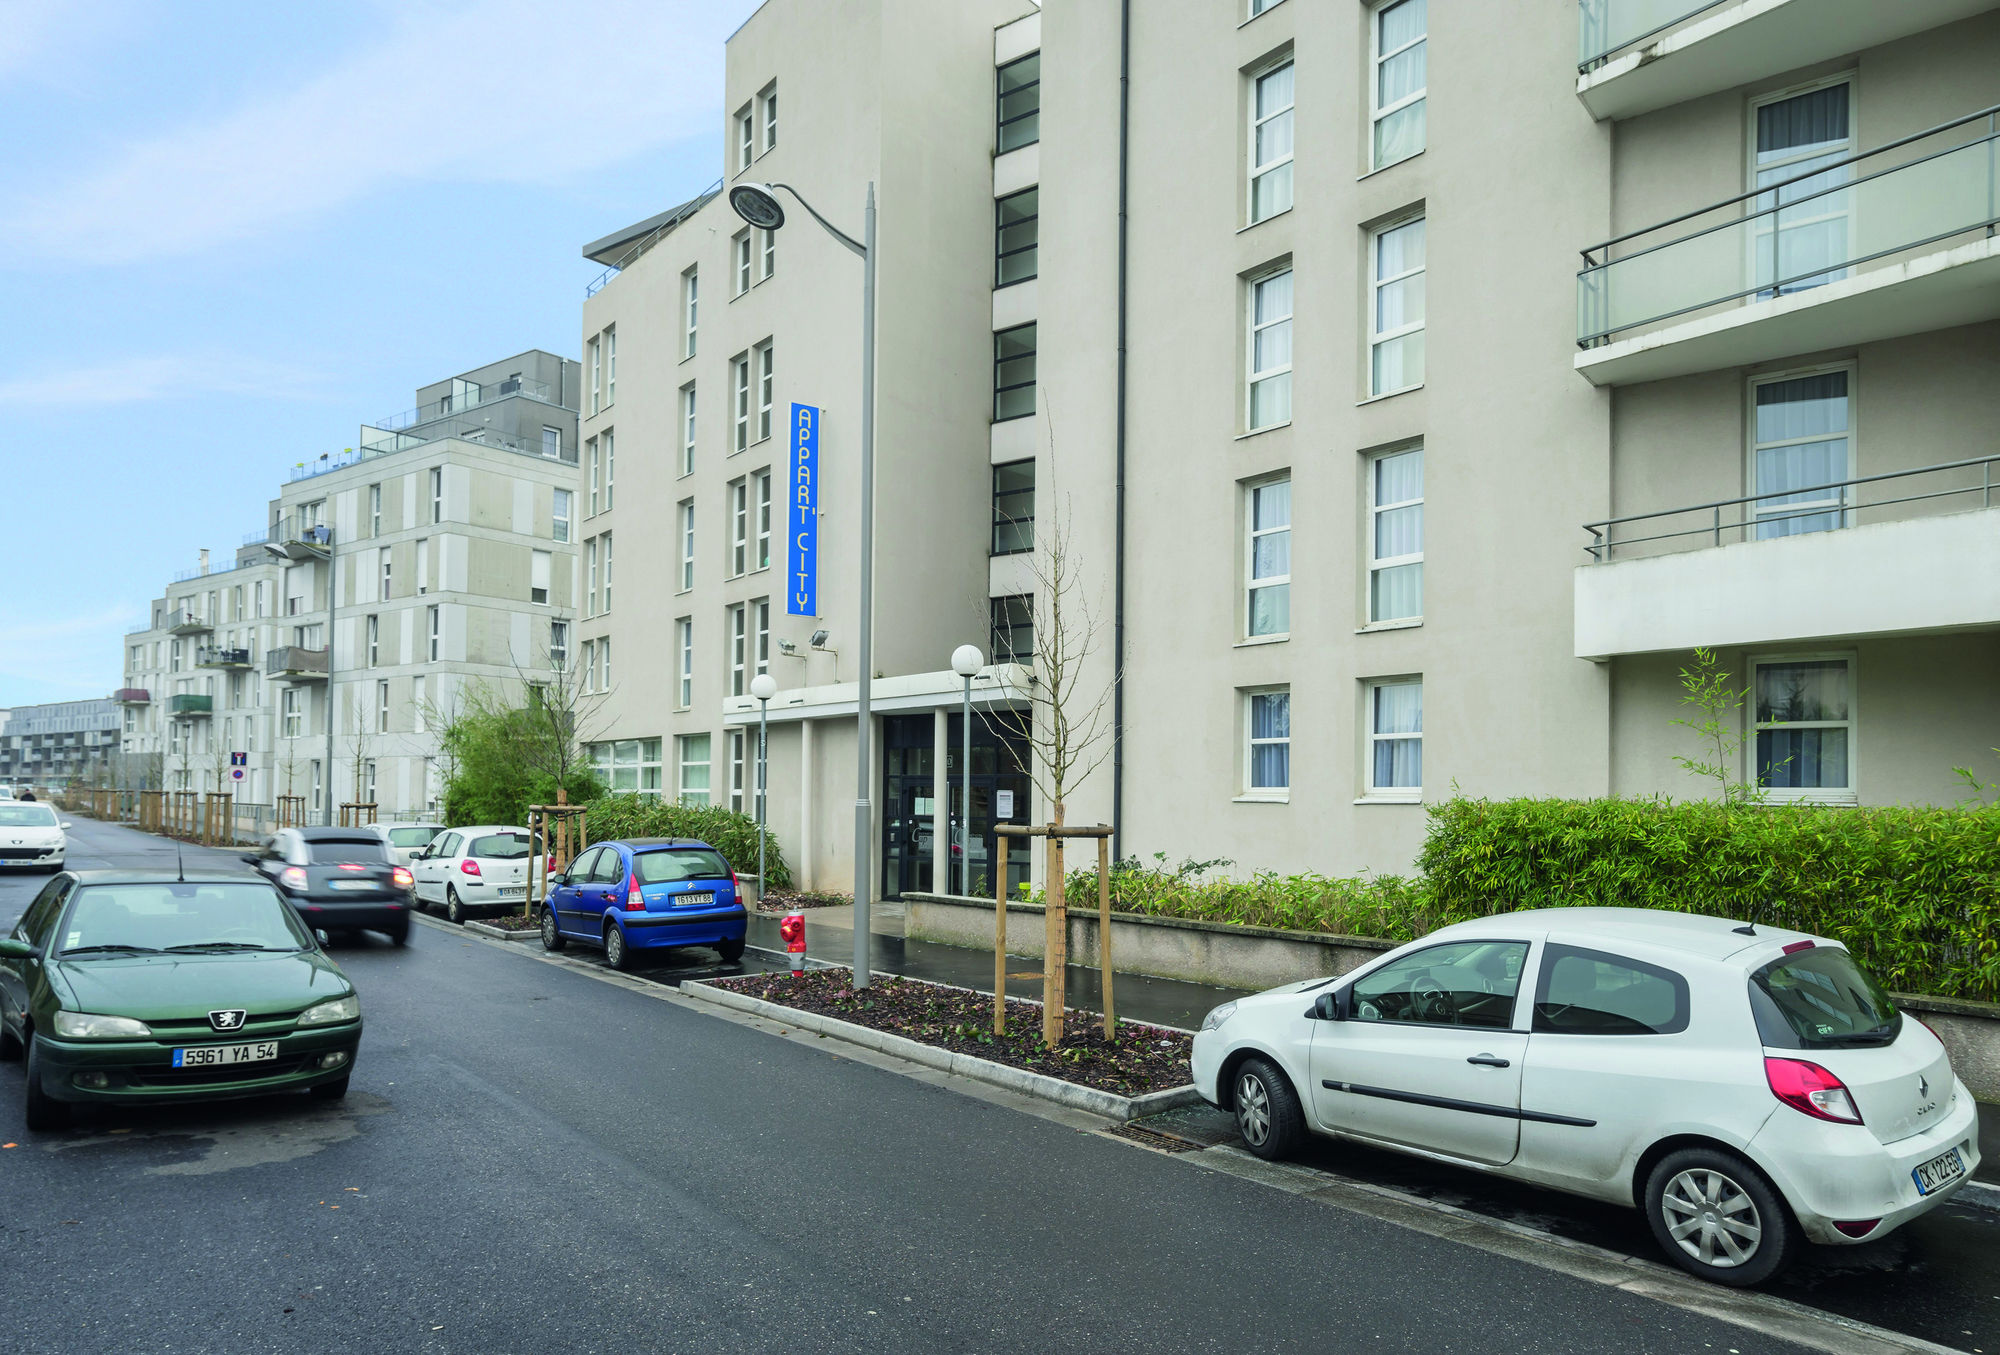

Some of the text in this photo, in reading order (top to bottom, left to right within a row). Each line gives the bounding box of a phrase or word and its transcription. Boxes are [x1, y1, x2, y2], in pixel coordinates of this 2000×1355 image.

[796, 408, 816, 612] APPART' CITY
[677, 895, 693, 904] 1613
[703, 894, 712, 902] 88
[185, 1044, 274, 1065] 5961 YA 54
[1917, 1102, 1936, 1116] CLIO
